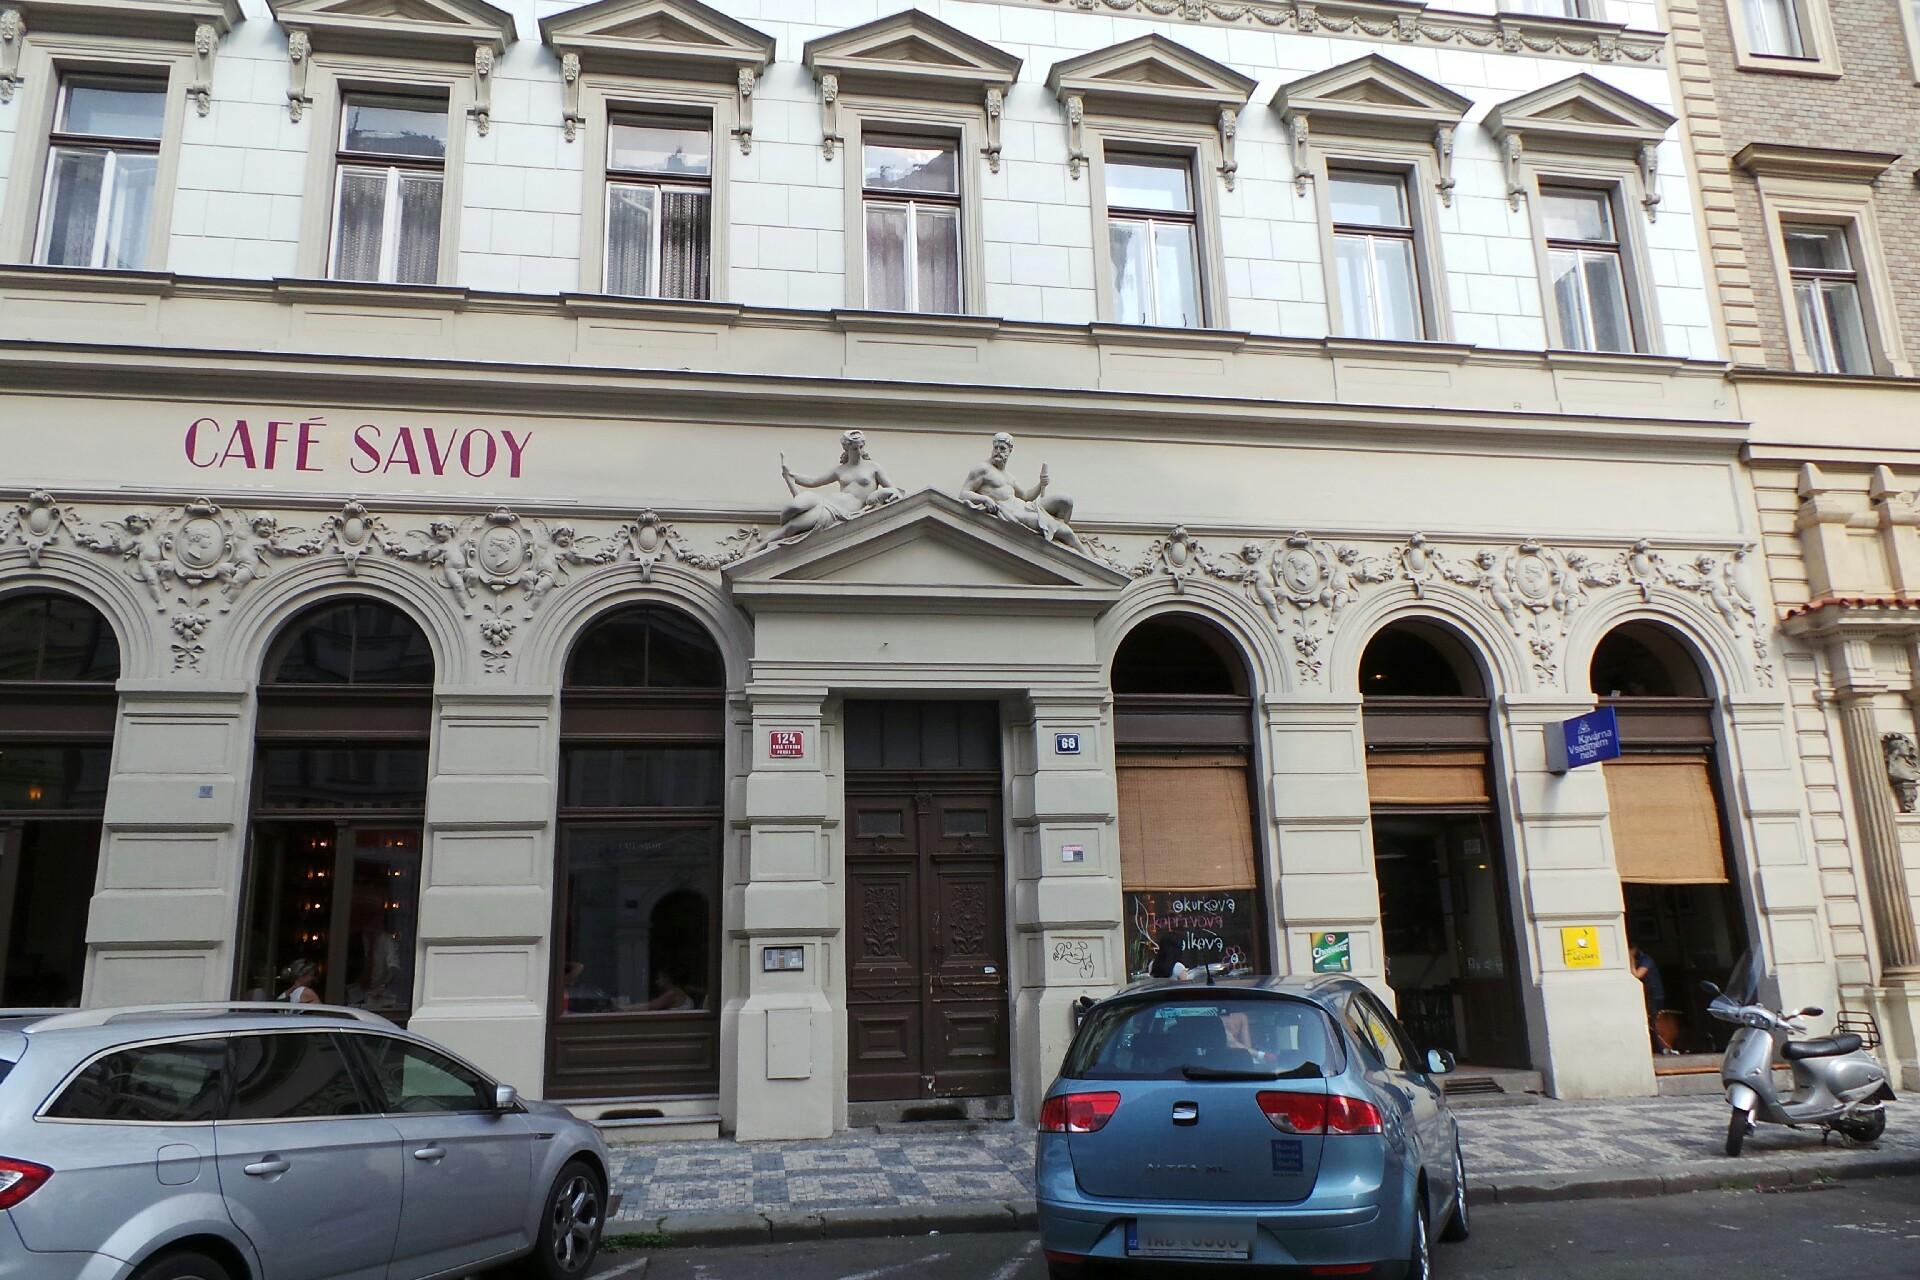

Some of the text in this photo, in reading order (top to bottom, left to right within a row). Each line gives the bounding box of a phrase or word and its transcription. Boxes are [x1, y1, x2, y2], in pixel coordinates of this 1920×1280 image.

[184, 416, 533, 478] CAFÉ SAVOY
[777, 732, 796, 744] 124
